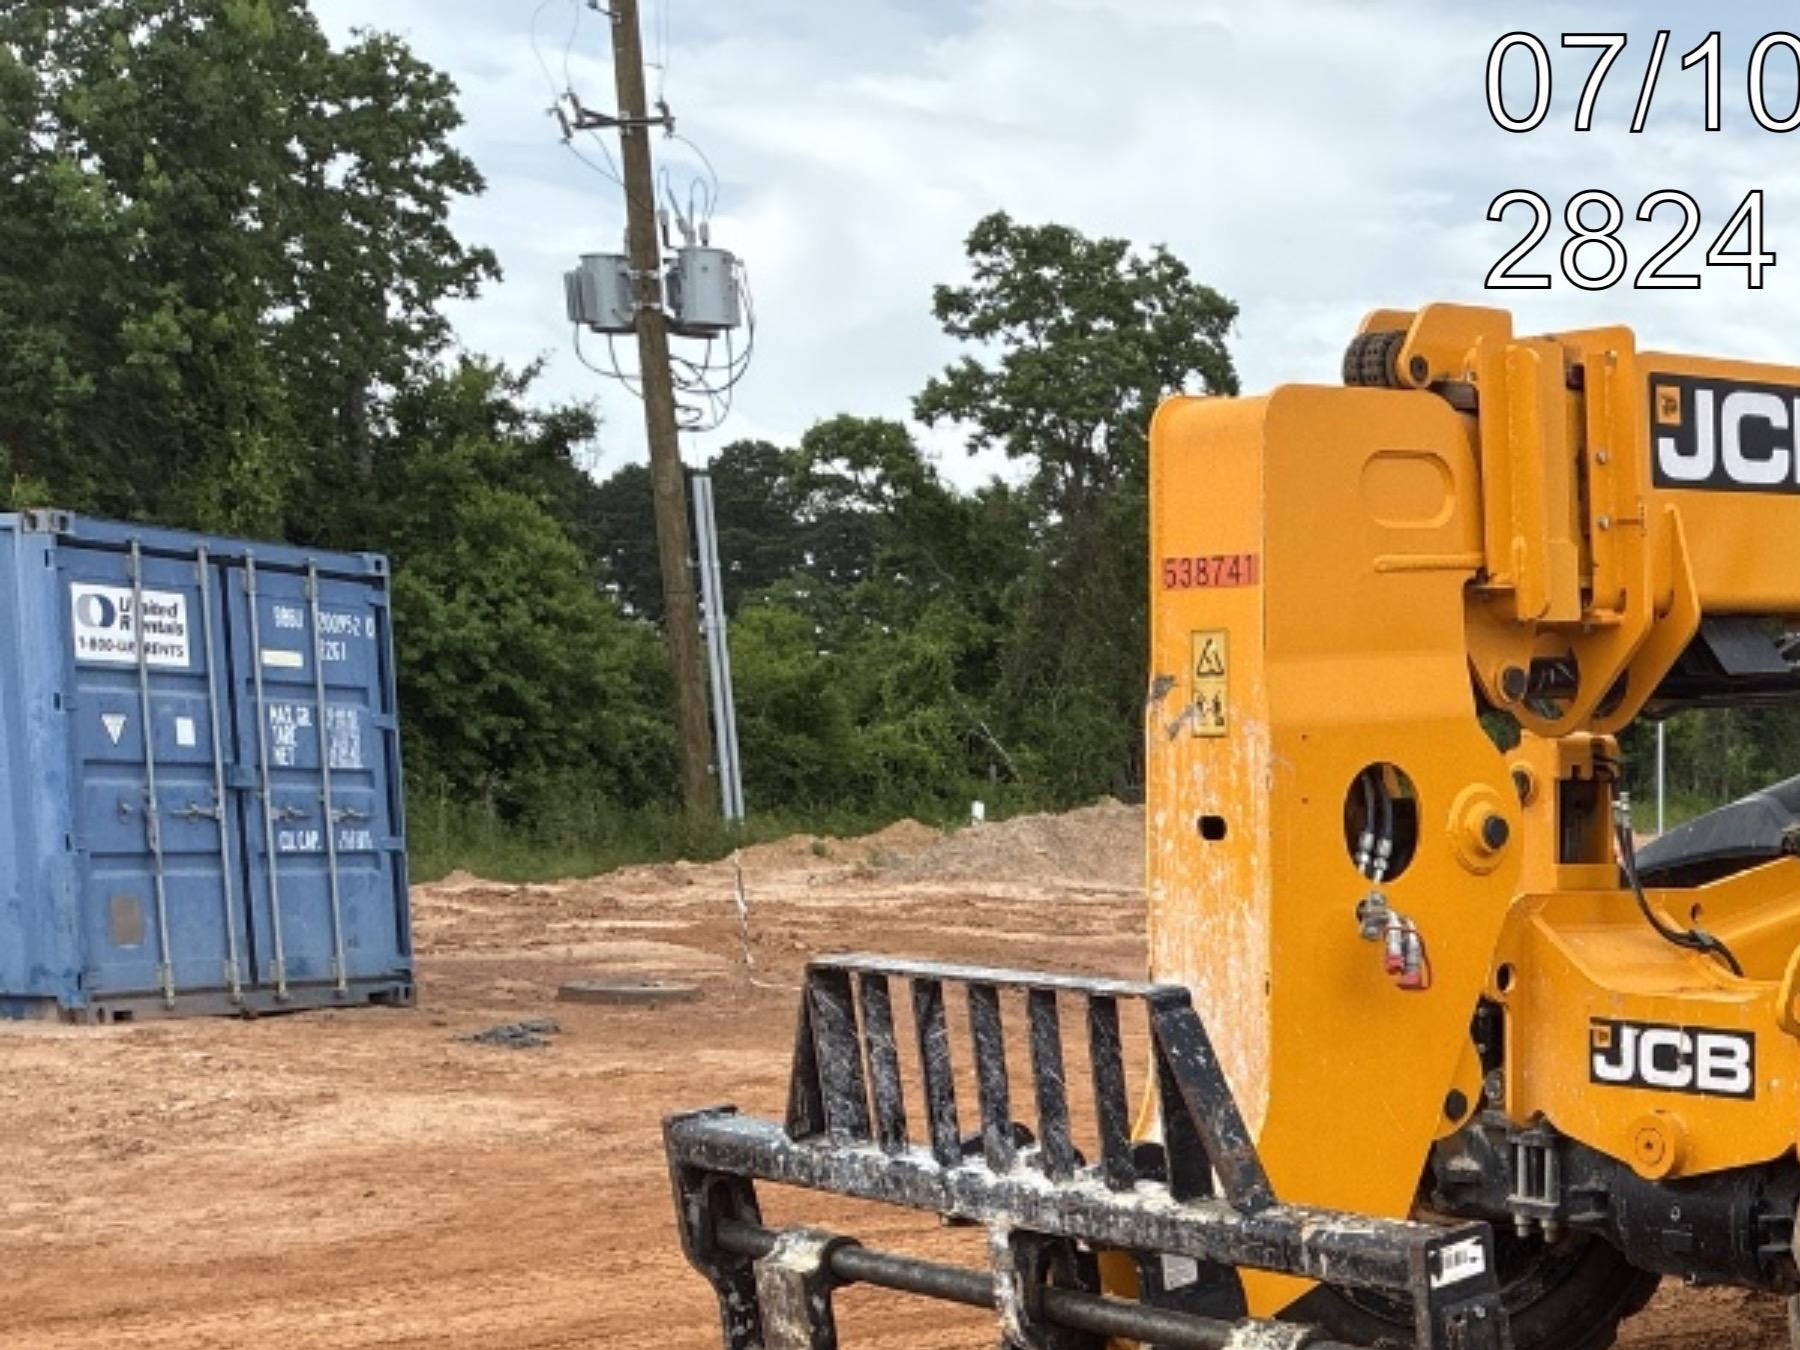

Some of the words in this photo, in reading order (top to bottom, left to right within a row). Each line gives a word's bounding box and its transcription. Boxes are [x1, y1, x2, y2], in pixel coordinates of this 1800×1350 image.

[1164, 553, 1253, 589] 538741
[120, 615, 184, 636] Rntals
[1593, 1025, 1751, 1093] JCB
